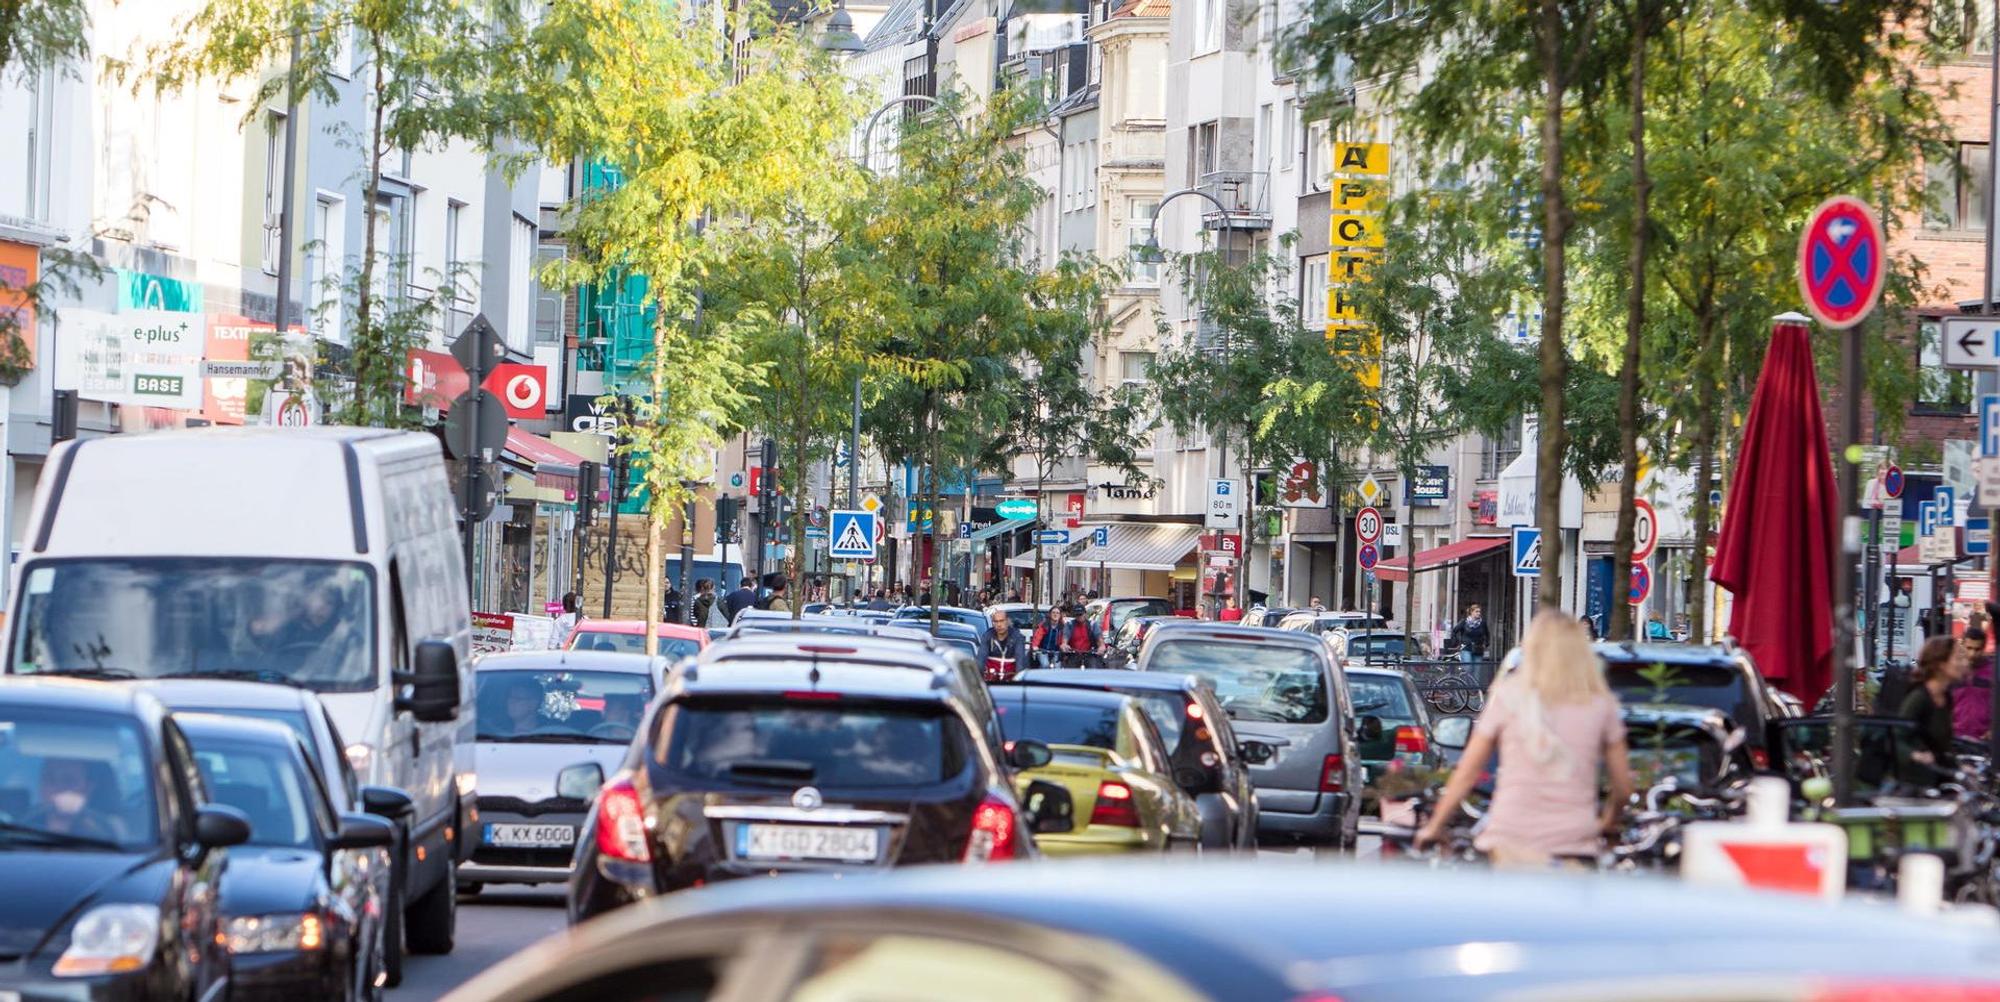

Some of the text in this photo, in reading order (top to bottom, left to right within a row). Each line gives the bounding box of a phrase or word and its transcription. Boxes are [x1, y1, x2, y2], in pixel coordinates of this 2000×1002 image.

[137, 377, 180, 393] BASE
[1213, 500, 1224, 509] 80
[1361, 517, 1377, 534] 30
[1385, 525, 1399, 536] DSL
[493, 826, 572, 842] K KX 6000
[753, 828, 765, 850] K
